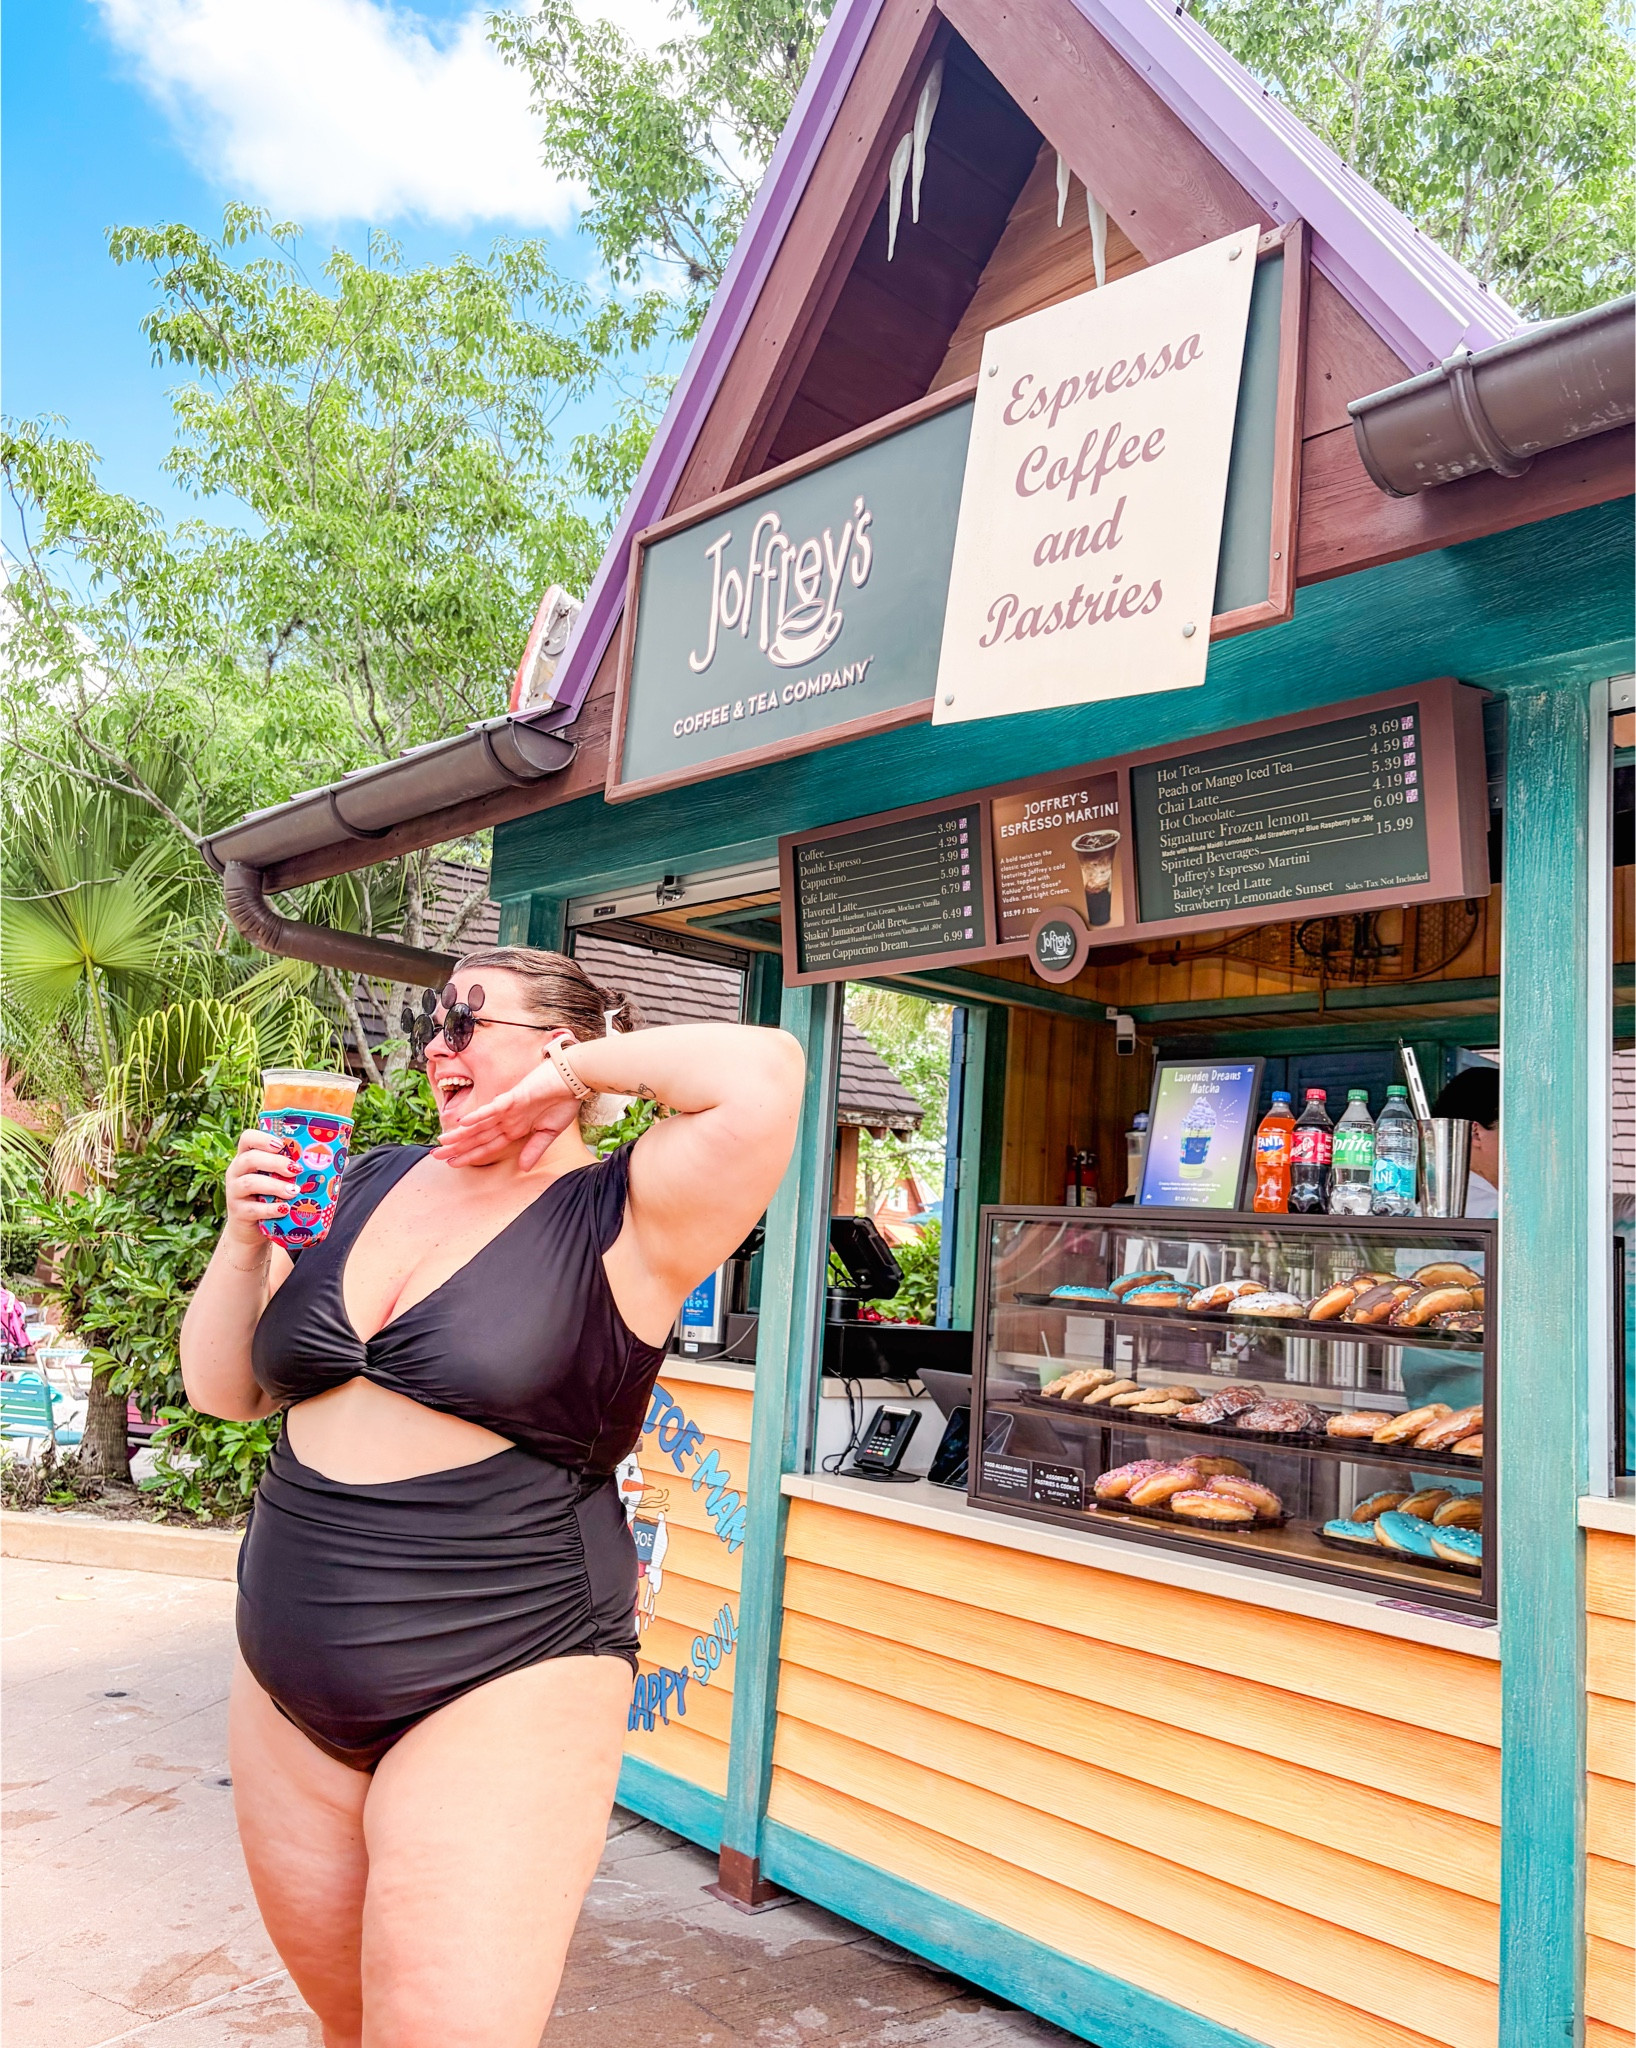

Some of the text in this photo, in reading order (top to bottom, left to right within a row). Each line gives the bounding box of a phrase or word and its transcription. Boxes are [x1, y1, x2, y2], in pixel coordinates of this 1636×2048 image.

[1002, 332, 1204, 430] Espresso
[1014, 421, 1167, 502] Coffee
[1032, 495, 1124, 568] and
[688, 495, 874, 674] Joffrey's
[978, 573, 1164, 650] Pastries
[673, 660, 869, 738] COFFEE & TEA COMPANY
[1157, 719, 1399, 783] Hot Tea 3.69
[1158, 737, 1400, 799] Peach or Mango Iced Tea 4.59
[1157, 756, 1401, 815] Chai Latte 5.39
[1160, 773, 1402, 832] Hot Chocolate 4.19
[1000, 801, 1119, 838] ESPRESSO MARTINI
[1023, 791, 1089, 820] JOFFREY'S
[1160, 791, 1404, 848] Signature Frozen lemon 6.09
[799, 820, 957, 862] Coffee 3.99
[1161, 849, 1176, 857] Made
[1176, 847, 1188, 855] with
[1188, 844, 1206, 853] Minute
[1255, 833, 1267, 841] Add
[1267, 827, 1298, 839] Strawberry
[1305, 824, 1319, 832] Blue
[1320, 818, 1351, 830] Raspberry
[1351, 816, 1360, 824] for
[1161, 816, 1414, 874] Spirited Beverages 15.99
[800, 836, 958, 876] Double Espresso 4.29
[801, 850, 959, 890] Cappuccino 5.99
[1001, 871, 1027, 880] featuring
[1053, 863, 1066, 871] cold
[1005, 855, 1018, 863] bold
[1019, 853, 1033, 861] twist
[1020, 859, 1043, 869] cocktail
[1172, 851, 1311, 888] Joffrey's Espresso Martini
[820, 891, 838, 902] Latte
[940, 867, 960, 880] 5.99
[1017, 876, 1037, 886] topped
[1033, 890, 1049, 900] Light
[1174, 881, 1334, 914] Strawberry Lemonade Sunset
[1217, 880, 1240, 894] Iced
[1243, 877, 1272, 889] Latte
[1345, 872, 1429, 891] Sales Tax Not Included
[803, 882, 960, 919] Flavored Latte 6.79
[898, 903, 914, 911] Mocha
[922, 899, 940, 907] Vanilla
[867, 919, 885, 932] Cold
[888, 918, 908, 928] Brew
[942, 907, 962, 920] 6.49
[805, 930, 963, 963] Frozen Cappuccino Dream 6.99
[1040, 930, 1072, 954] Joffrey's
[1174, 1069, 1242, 1083] Lavender Dreams
[1190, 1082, 1220, 1095] Matcha
[634, 1530, 655, 1547] JOE
[691, 1603, 740, 1687] SOUL
